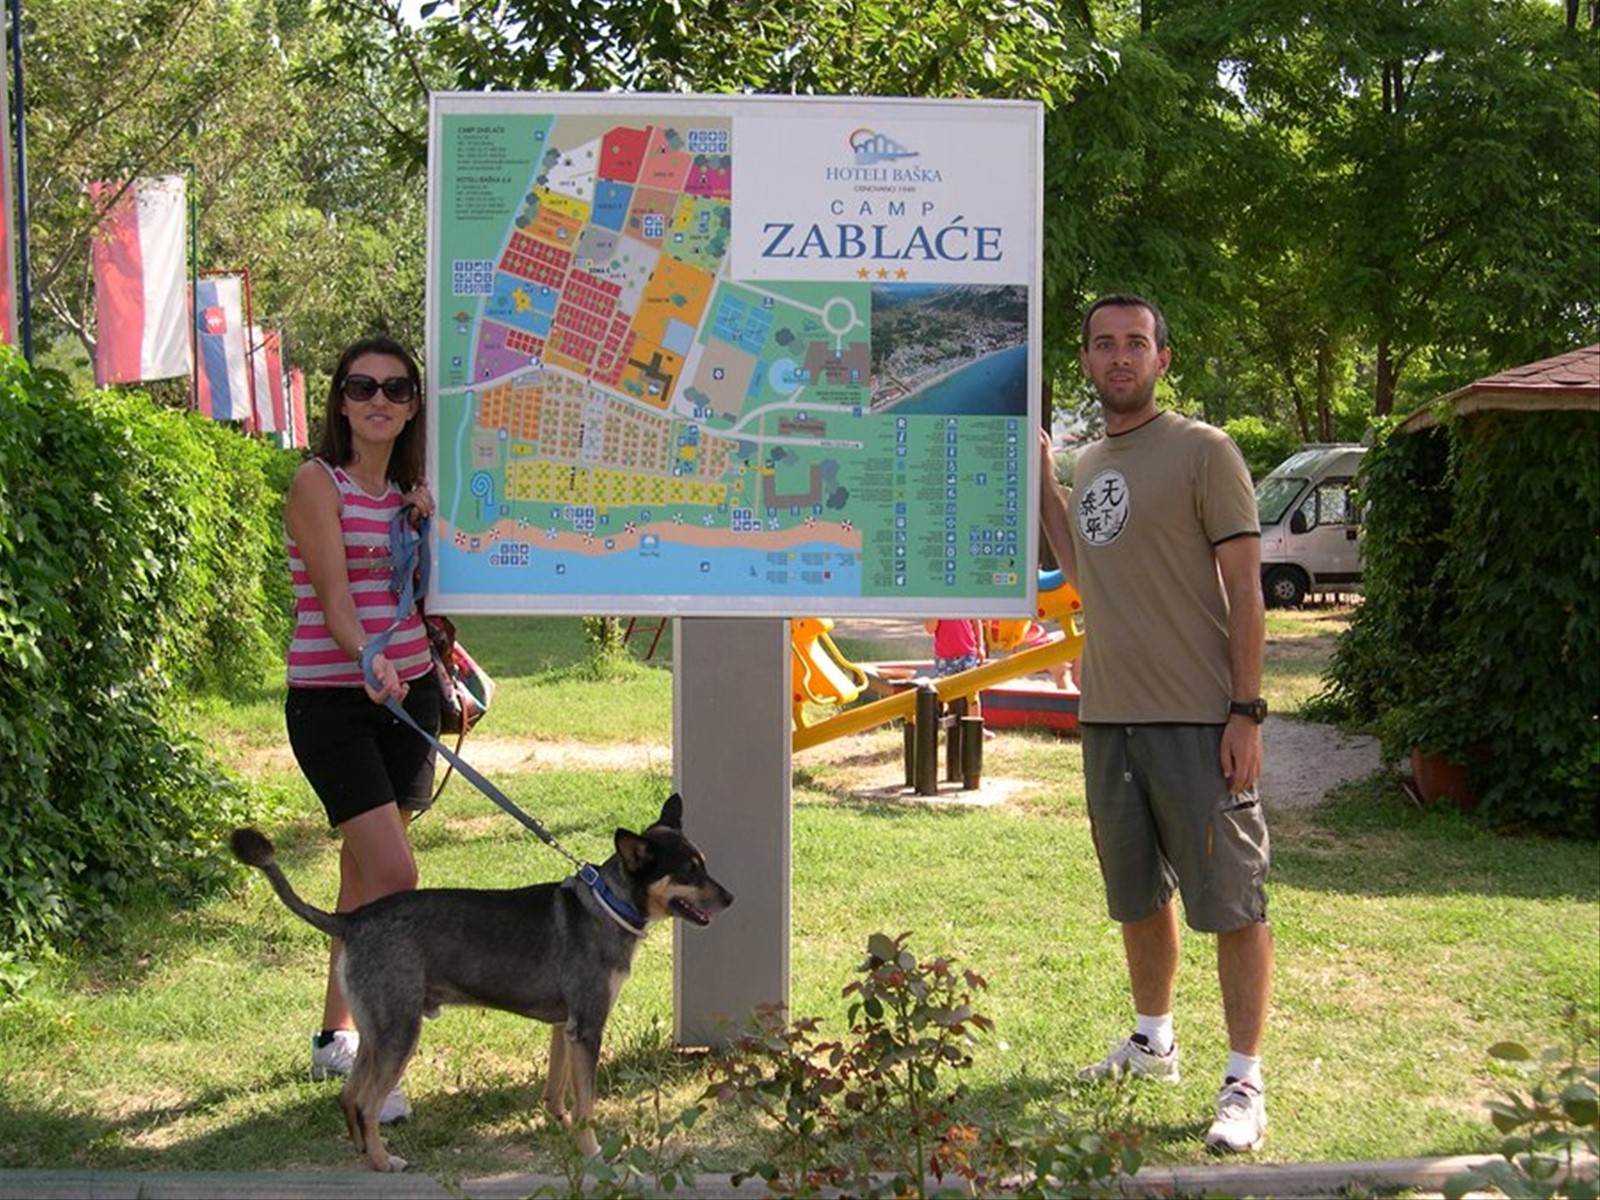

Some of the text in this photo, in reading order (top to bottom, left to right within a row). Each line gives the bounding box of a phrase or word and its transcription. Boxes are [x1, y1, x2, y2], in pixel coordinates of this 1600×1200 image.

[826, 165, 942, 182] HOTELI BAŠKA
[830, 199, 934, 216] CAMP
[761, 214, 1003, 262] ZABLAĆE
